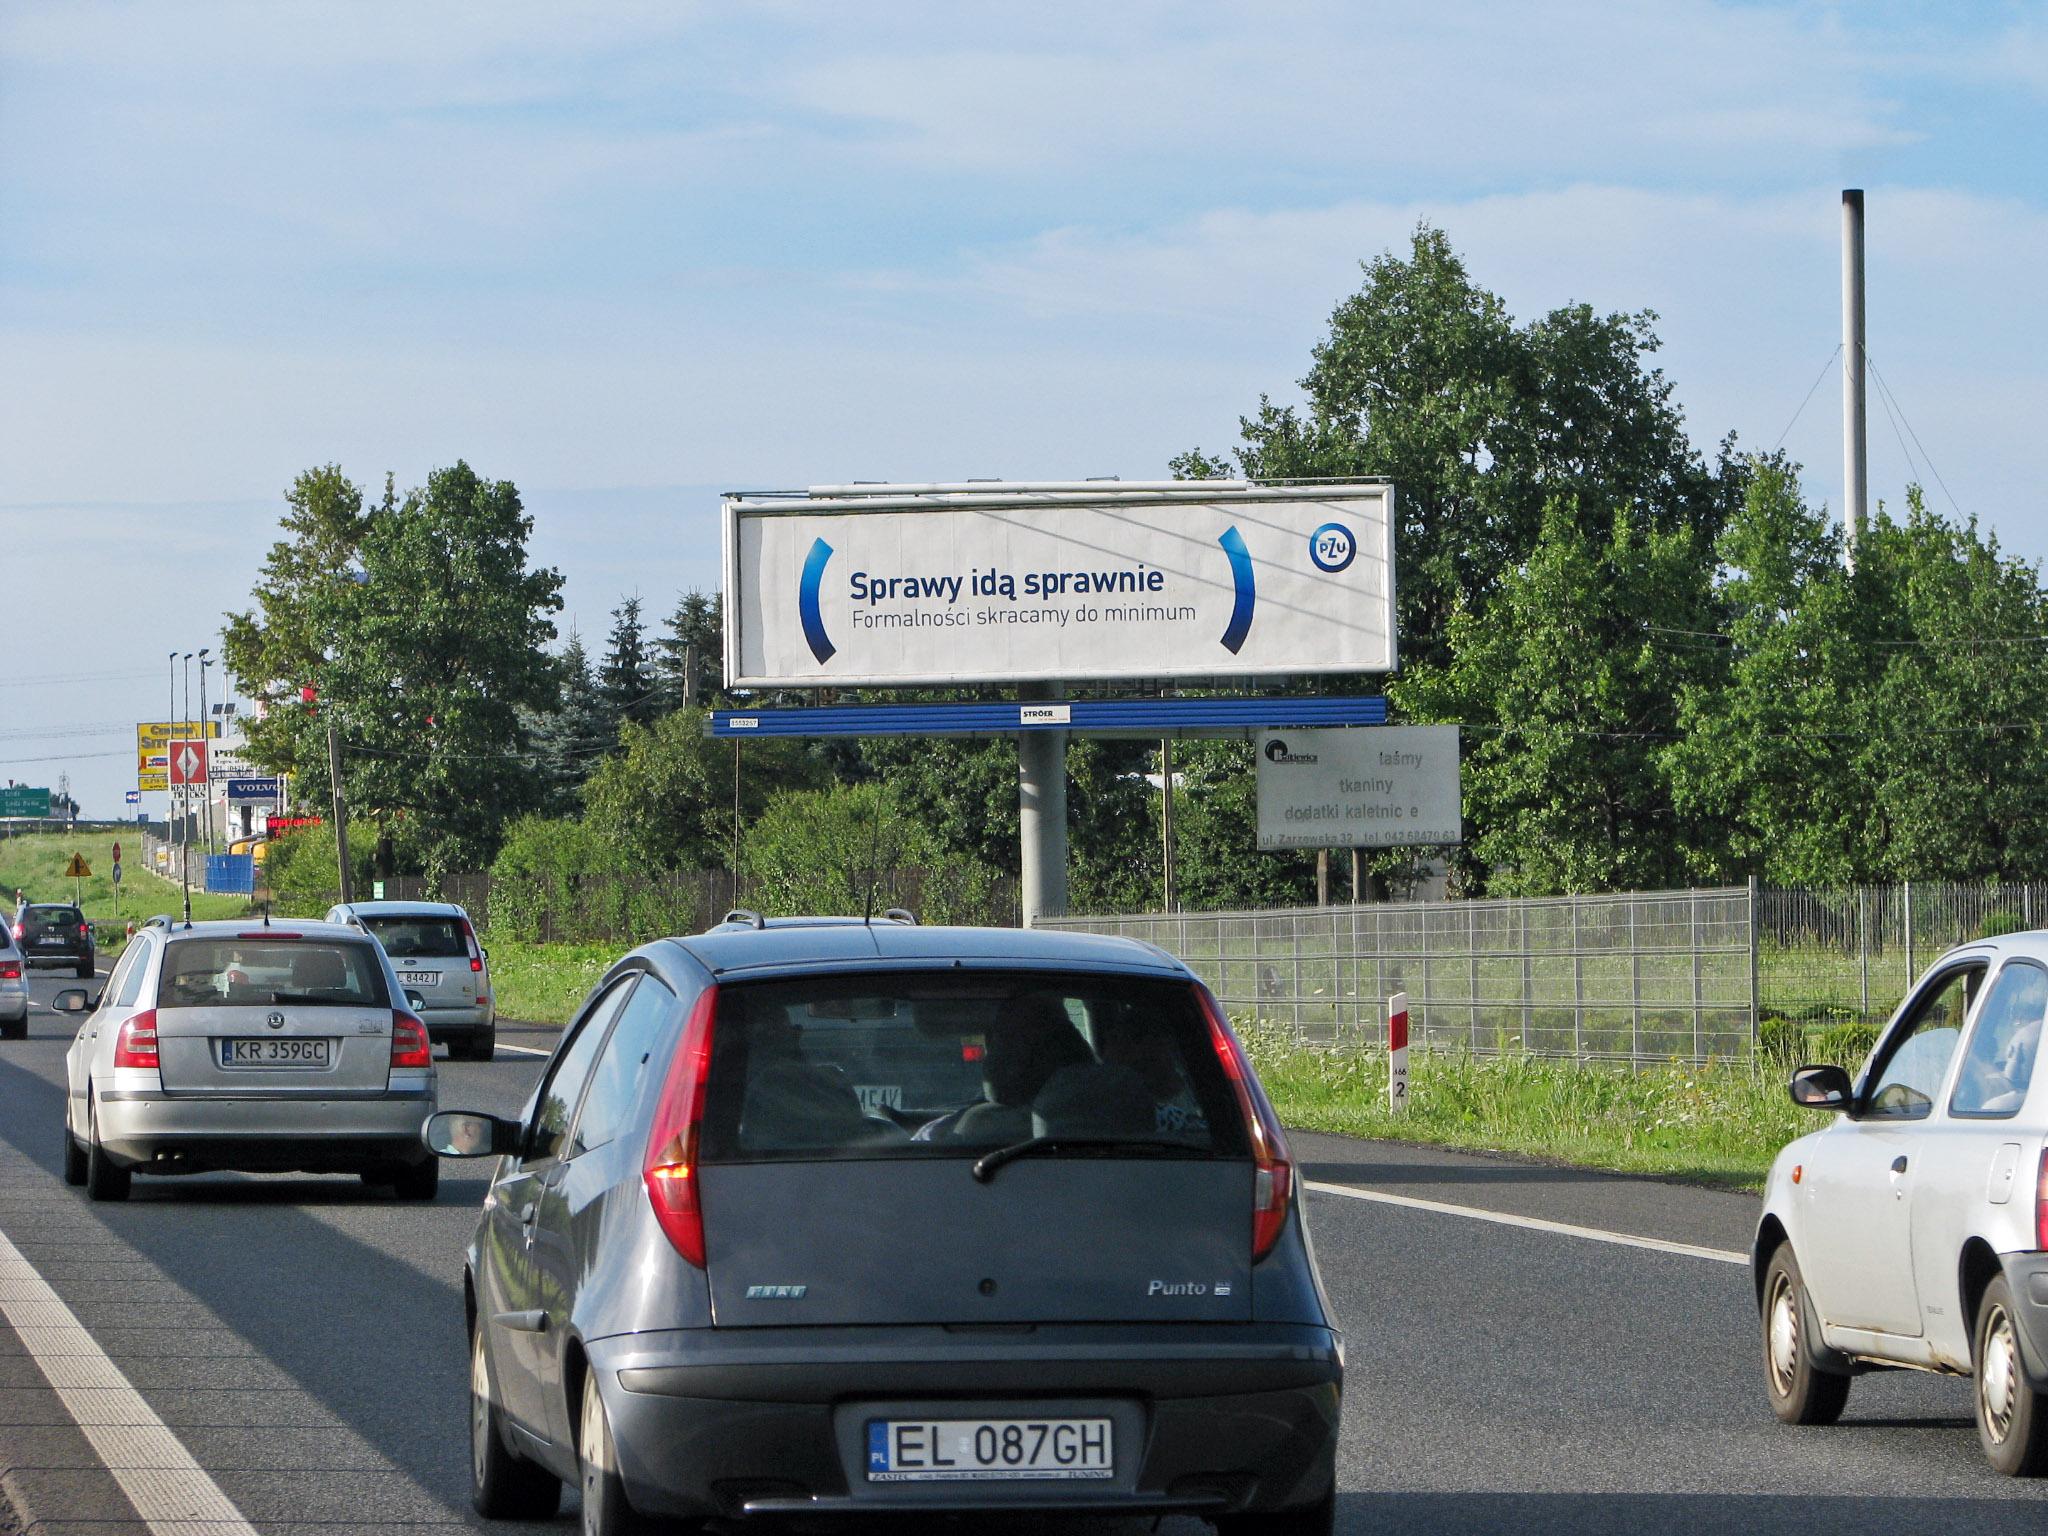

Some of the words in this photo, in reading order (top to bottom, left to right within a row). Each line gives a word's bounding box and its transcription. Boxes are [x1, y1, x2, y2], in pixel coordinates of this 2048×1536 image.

[1320, 537, 1346, 559] PZU
[850, 571, 964, 606] Sprawy
[972, 567, 1017, 601] idą
[1024, 564, 1165, 601] sprawnie
[853, 607, 970, 629] Formalności
[976, 606, 1070, 628] skracamy
[1075, 604, 1098, 623] do
[1105, 602, 1197, 621] minimum
[1023, 710, 1054, 718] STRÖER
[1380, 750, 1423, 769] taśmy
[1340, 778, 1394, 794] tkaniny
[174, 791, 206, 799] TRCKS
[1285, 804, 1339, 820] dodatki
[235, 1042, 261, 1059] KR
[269, 1042, 324, 1060] 359GC
[1396, 1081, 1406, 1098] 2
[746, 1285, 807, 1299] FIAT
[1148, 1279, 1206, 1296] Punto
[896, 1425, 955, 1467] EL
[975, 1424, 1105, 1466] 087GH
[871, 1452, 887, 1464] PL
